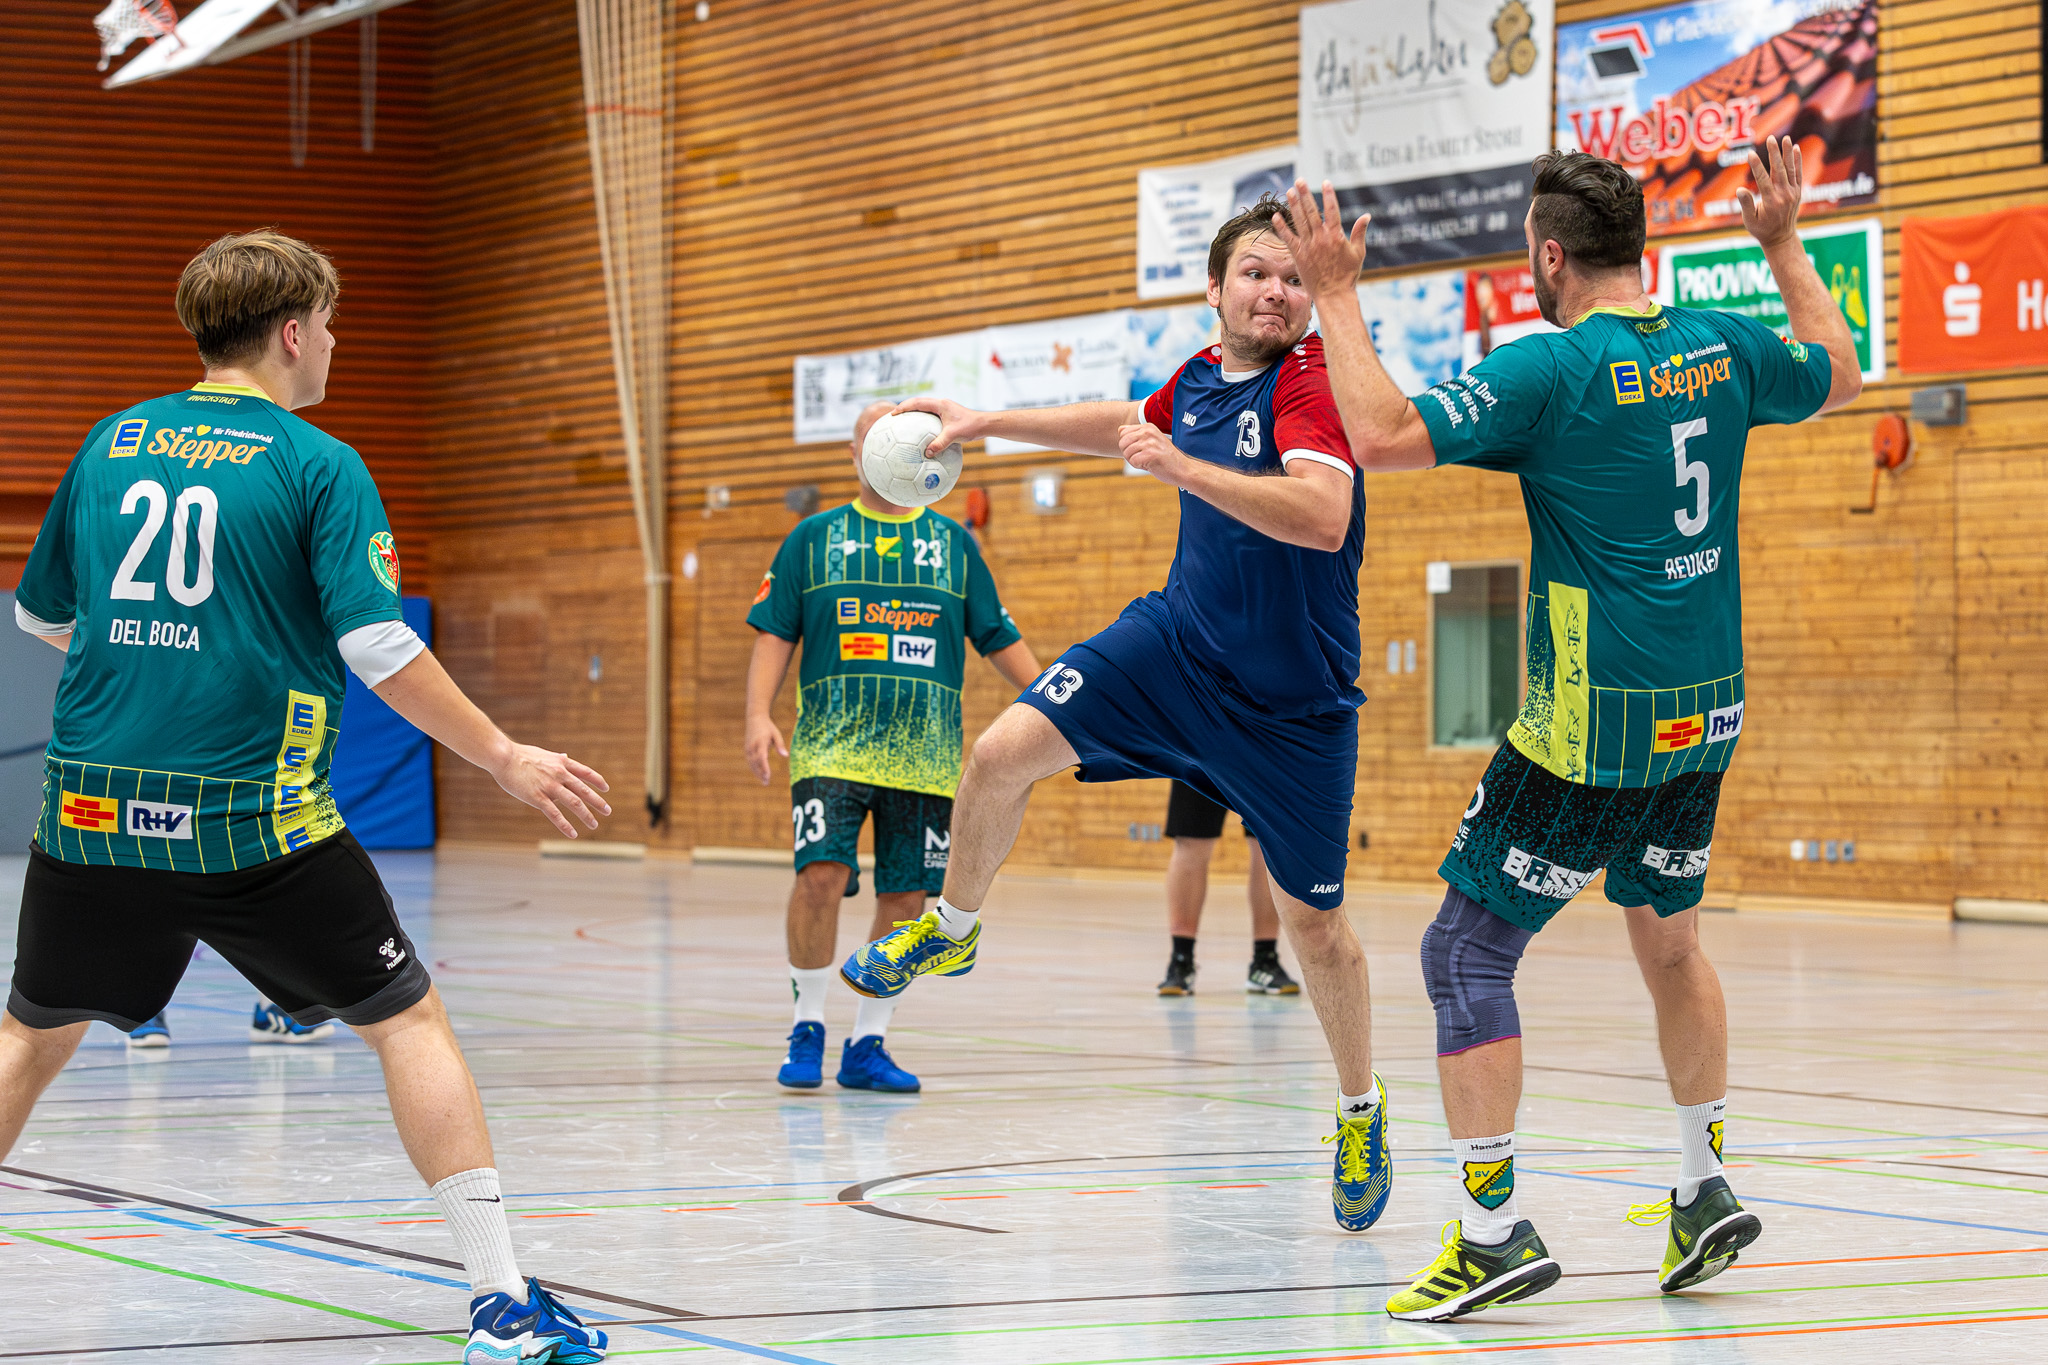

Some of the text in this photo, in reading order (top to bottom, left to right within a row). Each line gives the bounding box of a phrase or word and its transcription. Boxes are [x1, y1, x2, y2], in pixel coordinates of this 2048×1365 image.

[1567, 95, 1764, 164] Weber
[1649, 356, 1732, 402] Stepper
[1619, 394, 1642, 403] EDEKA
[181, 425, 194, 433] mit
[1182, 411, 1197, 427] JAKO
[1235, 410, 1261, 458] 13
[147, 428, 268, 469] Stepper
[1670, 416, 1710, 537] 5
[110, 479, 219, 607] 20
[912, 538, 943, 569] 23
[864, 603, 940, 632] Stepper
[109, 618, 200, 651] DEL BOCA
[898, 641, 933, 659] R+V
[1031, 662, 1084, 704] 13
[291, 727, 313, 736] EDEKA
[132, 807, 188, 833] R+V
[792, 798, 826, 852] 23
[1310, 883, 1340, 894] JAKO
[1470, 1138, 1512, 1151] Handball
[1474, 1169, 1491, 1178] SV
